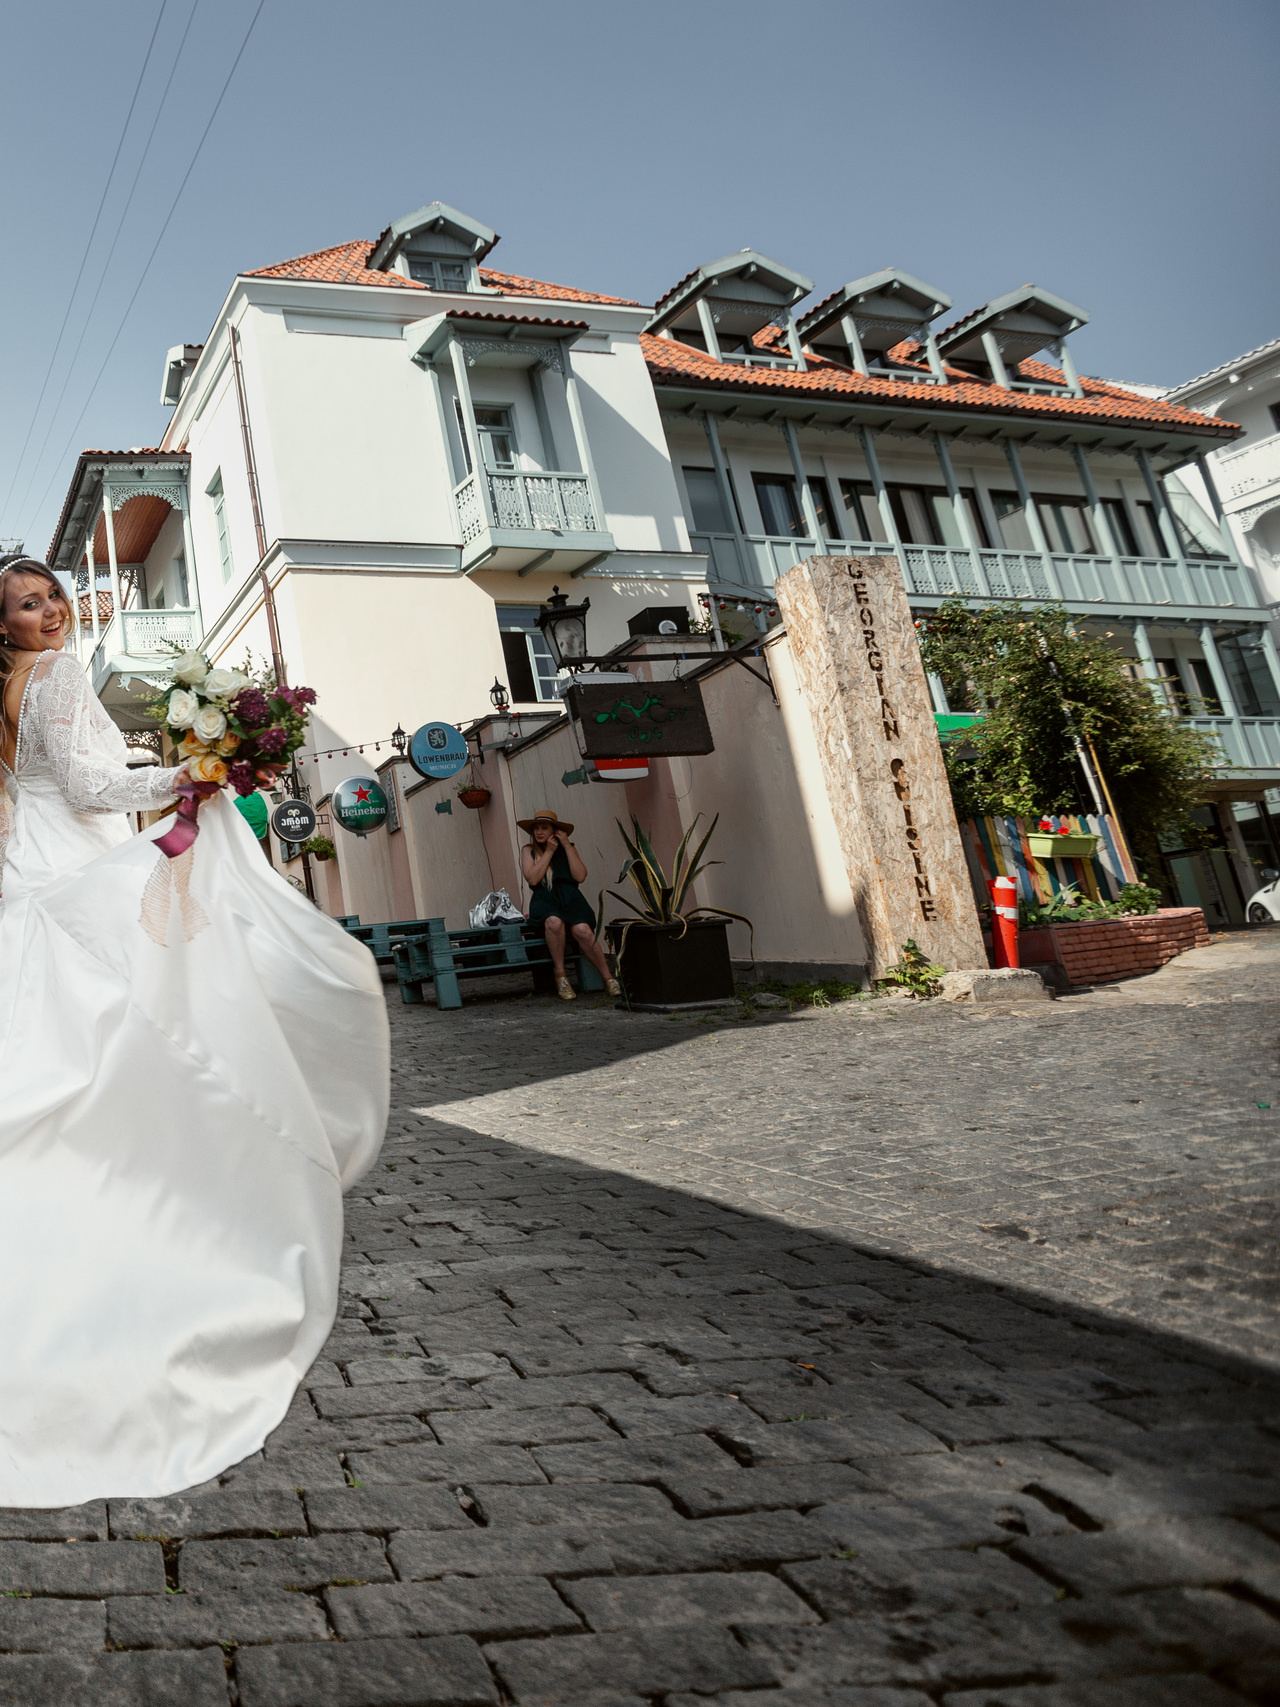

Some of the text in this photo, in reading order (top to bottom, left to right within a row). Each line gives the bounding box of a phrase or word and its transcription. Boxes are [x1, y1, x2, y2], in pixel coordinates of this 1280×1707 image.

[341, 806, 386, 817] Heineken
[847, 559, 937, 922] GEORGIAN CUISINE
